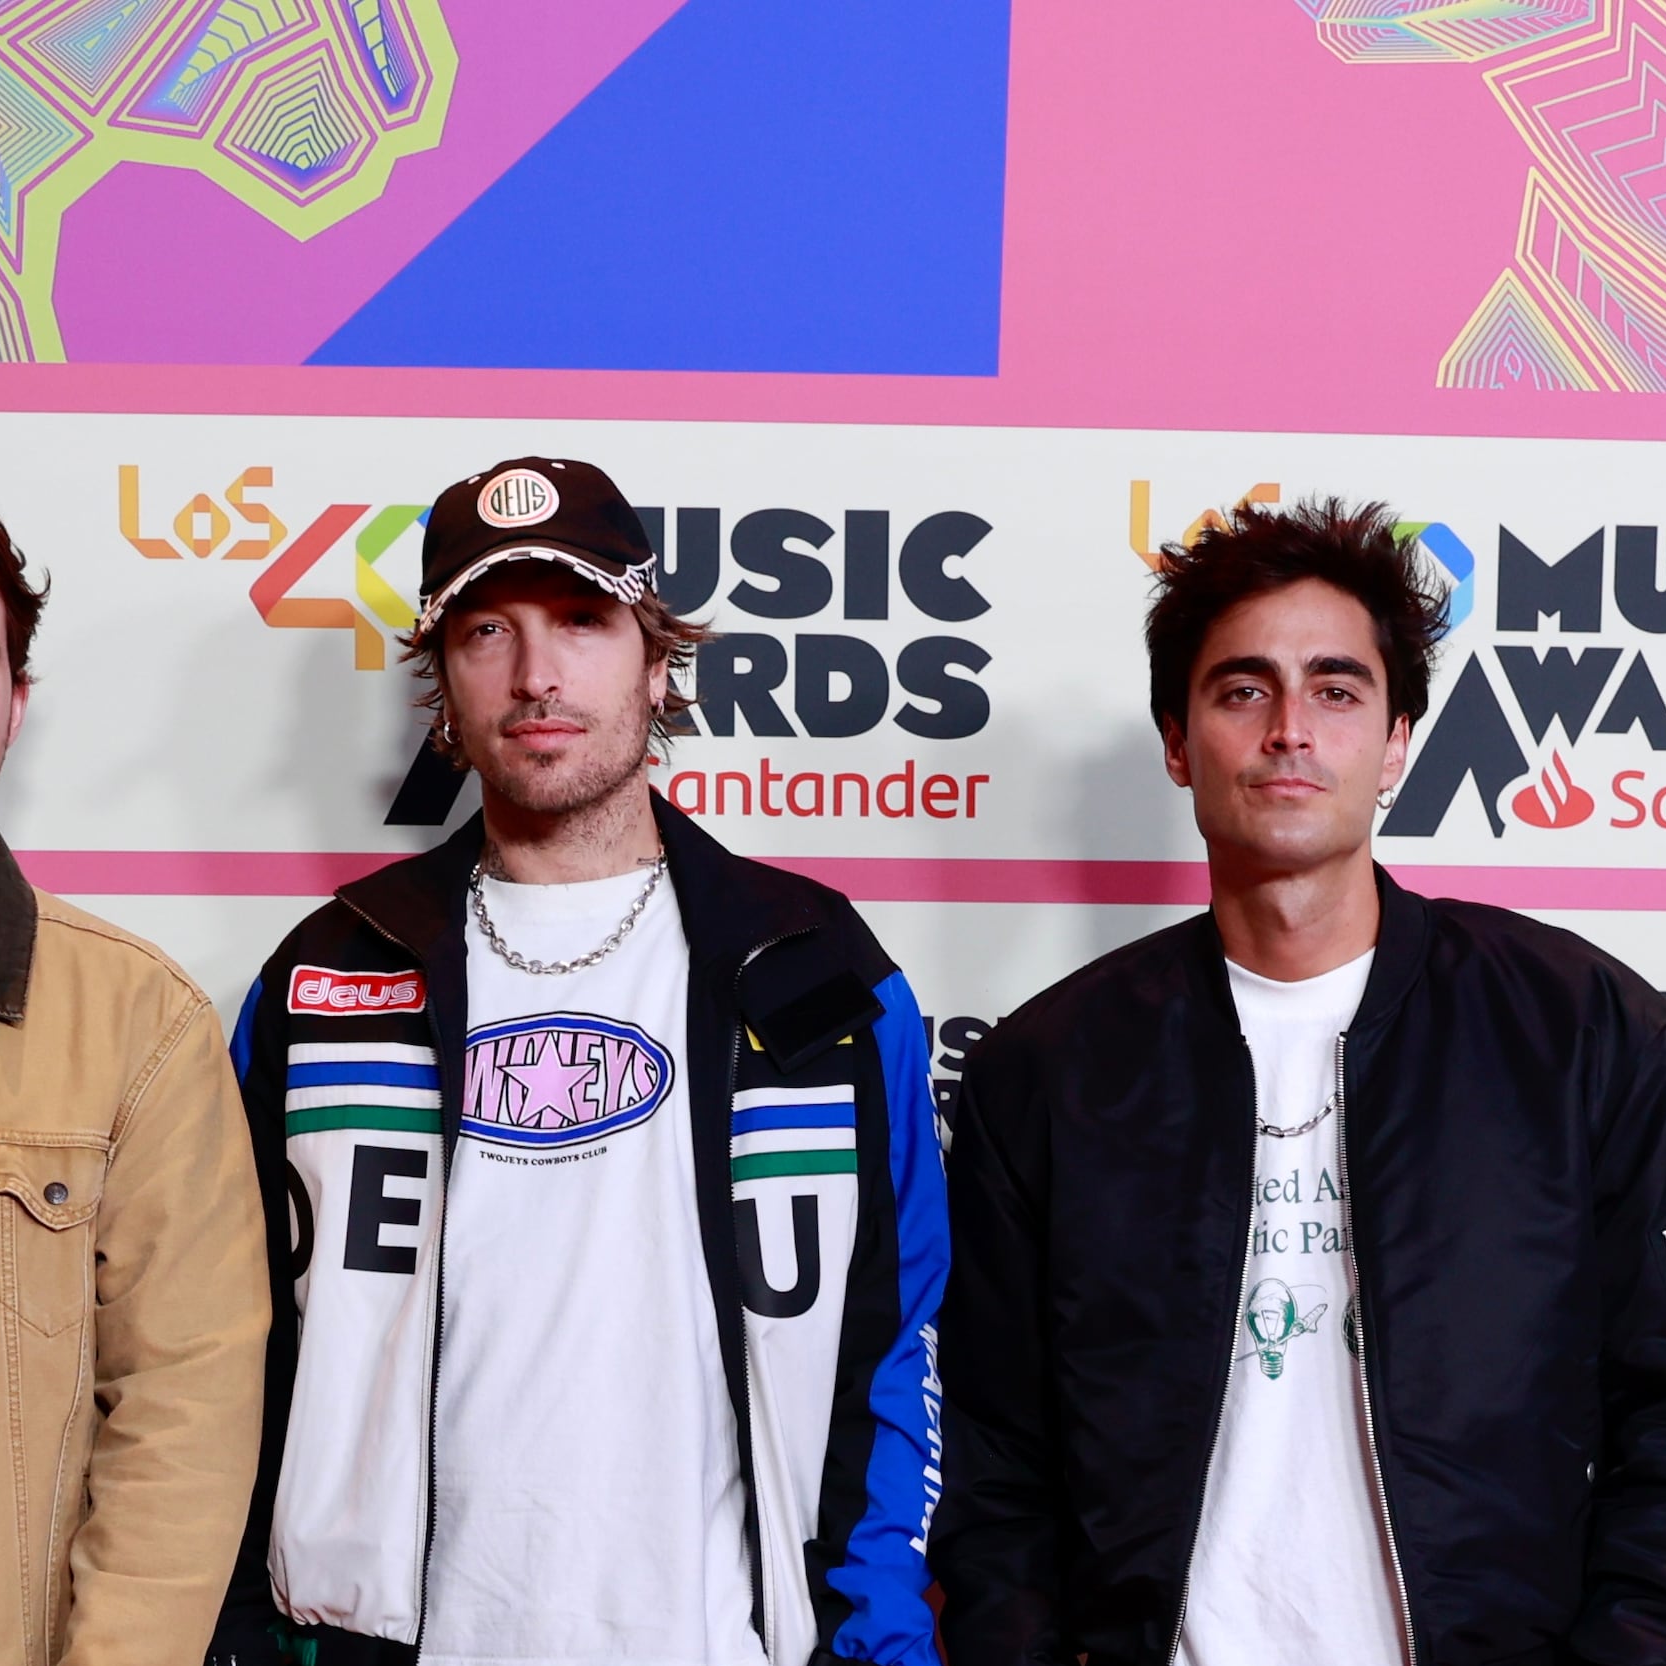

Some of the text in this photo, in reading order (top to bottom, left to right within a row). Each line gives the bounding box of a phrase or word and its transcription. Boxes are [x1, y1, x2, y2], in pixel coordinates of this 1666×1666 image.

[490, 478, 546, 517] DEUS
[641, 506, 993, 620] USIC
[650, 757, 990, 820] antander
[297, 977, 418, 1008] deus
[479, 1146, 608, 1166] TWOJEYS COWBOYS CLUB
[1255, 1169, 1302, 1206] ted
[1252, 1220, 1289, 1256] tic
